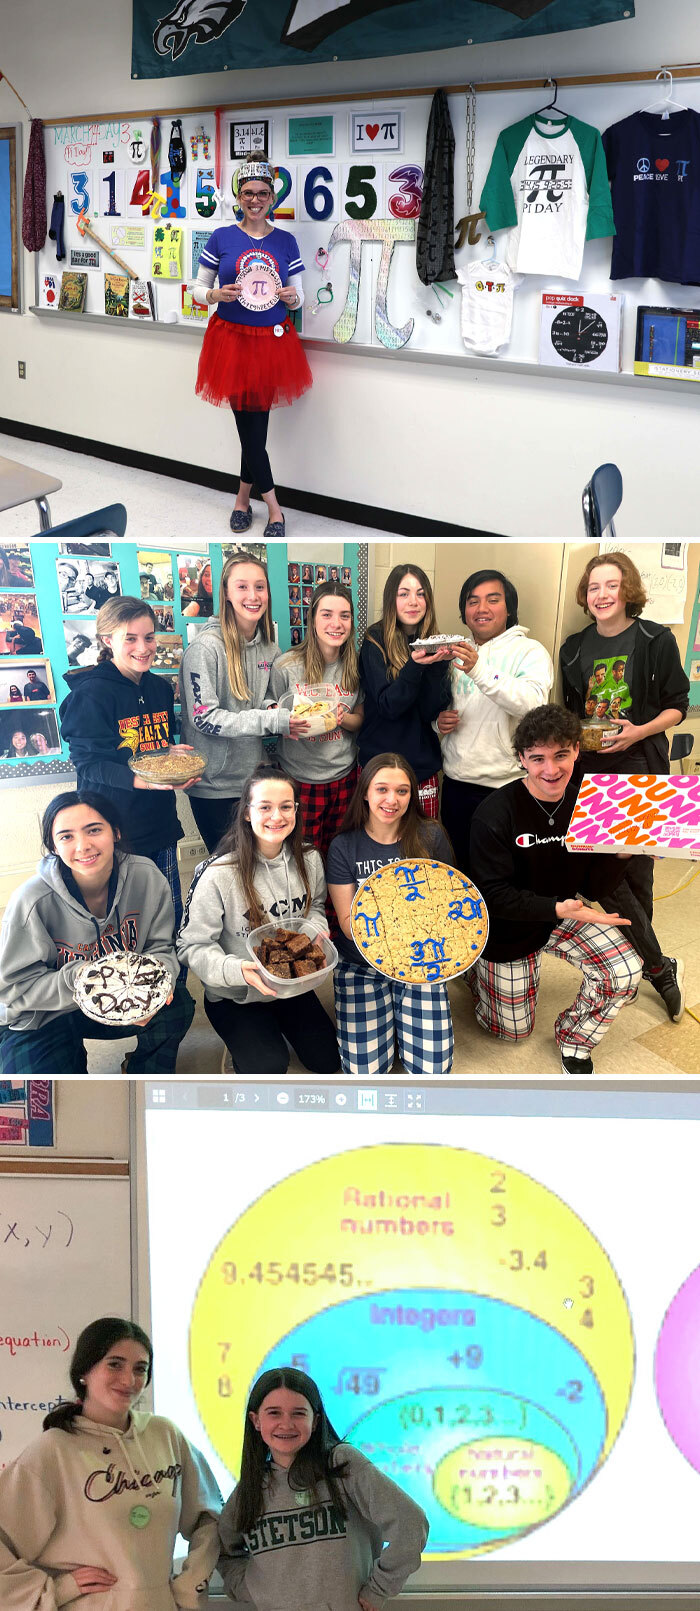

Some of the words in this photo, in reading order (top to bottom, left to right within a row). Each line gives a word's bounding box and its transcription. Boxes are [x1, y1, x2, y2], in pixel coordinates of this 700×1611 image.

[356, 124, 364, 141] I
[524, 154, 575, 166] LEGENDARY
[633, 173, 654, 181] PEACE
[655, 173, 669, 181] LOVE
[71, 171, 90, 216] 3
[103, 170, 121, 216] 1
[129, 169, 153, 216] 4
[304, 166, 334, 221] 6
[344, 165, 377, 220] 5
[523, 203, 532, 214] PI
[535, 202, 563, 214] DAY
[193, 715, 222, 736] CURE
[356, 859, 384, 874] THIS
[96, 991, 152, 1015] Day
[298, 1094, 326, 1104] 173%
[343, 1187, 450, 1210] Rational
[340, 1216, 454, 1237] numbers
[370, 1303, 476, 1333] Integers
[248, 1504, 347, 1551] STETSON
